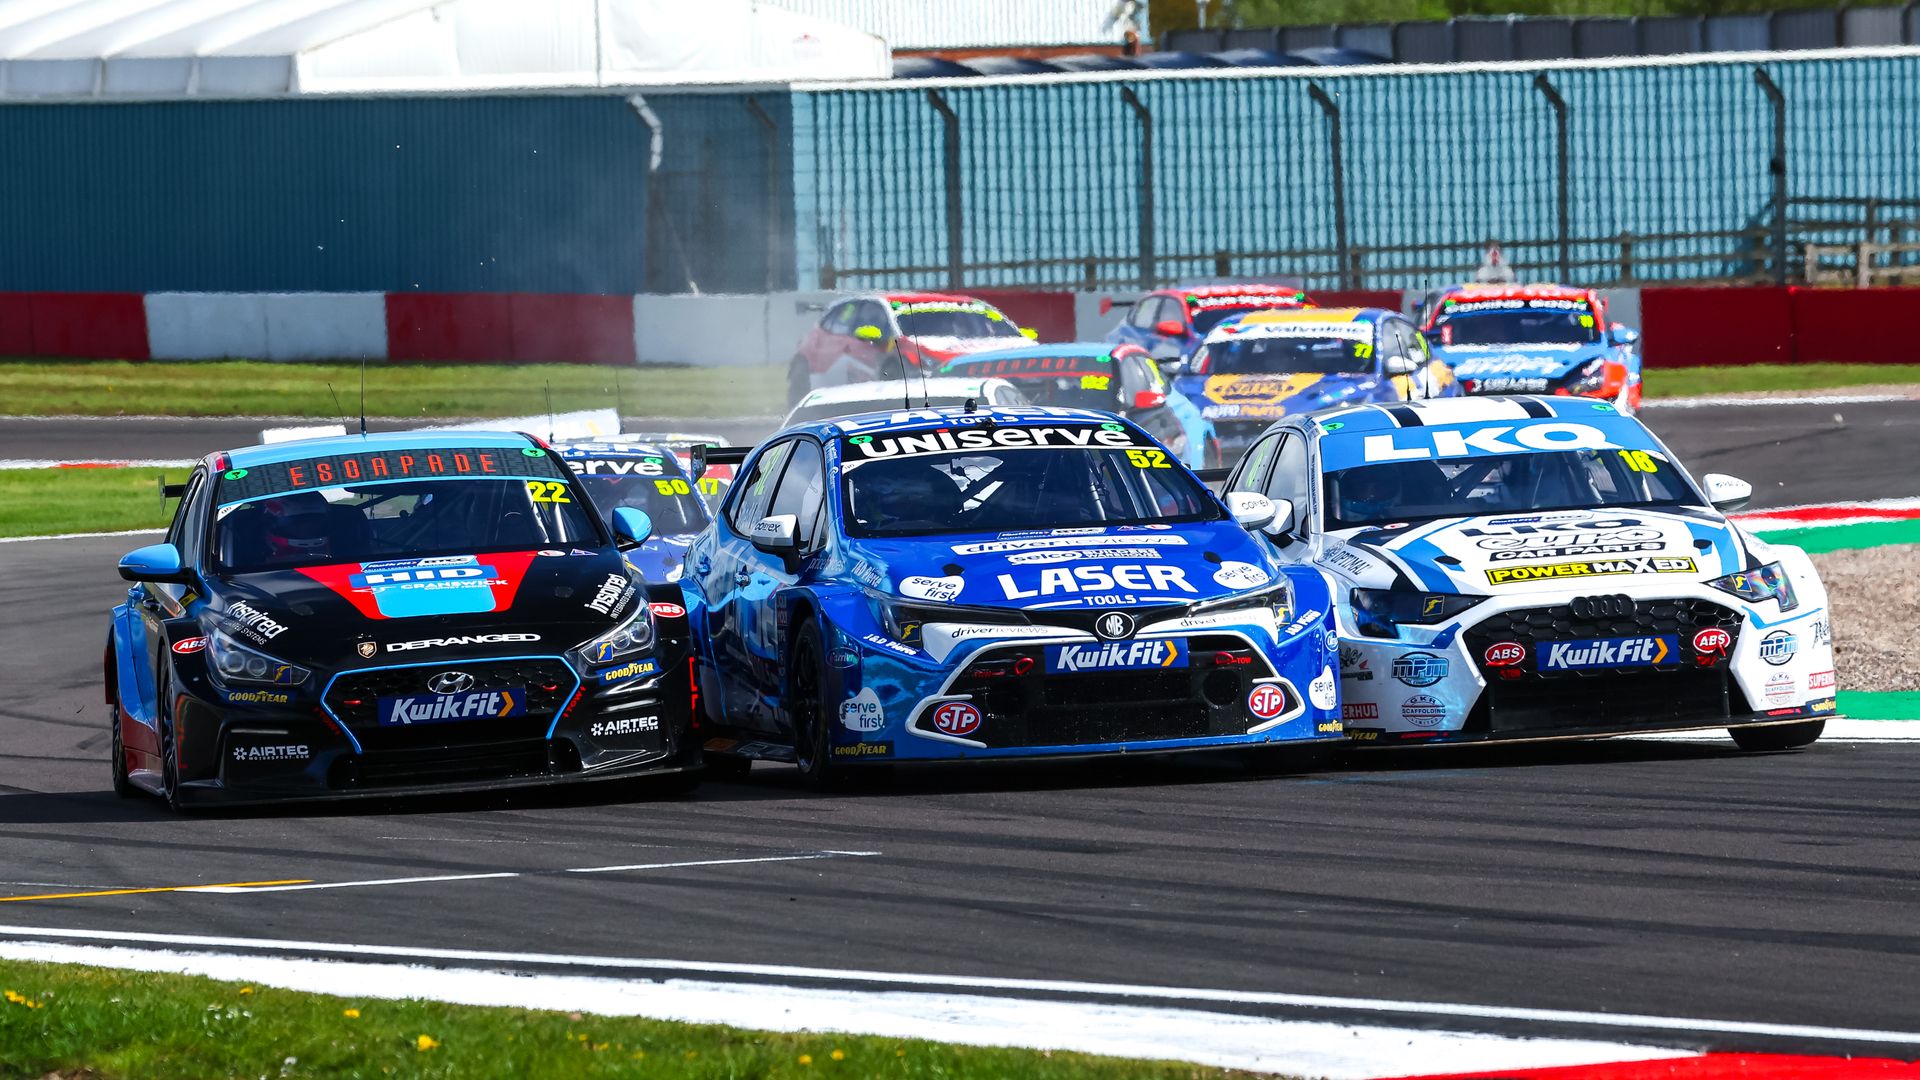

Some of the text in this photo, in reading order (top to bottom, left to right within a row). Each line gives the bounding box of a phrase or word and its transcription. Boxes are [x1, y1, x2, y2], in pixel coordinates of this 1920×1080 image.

[1364, 423, 1624, 463] LKQ
[566, 460, 664, 476] erve
[1125, 450, 1172, 469] 52
[527, 481, 571, 504] 22
[654, 478, 691, 496] 50
[699, 477, 719, 496] 17
[1461, 519, 1651, 537] LKQ
[1496, 542, 1661, 560] CAR PARTS
[365, 568, 484, 584] HID
[1219, 564, 1253, 581] serve
[1493, 562, 1592, 582] POWER
[912, 577, 957, 590] serve
[997, 565, 1199, 601] LASER
[584, 573, 628, 615] inspired
[1084, 594, 1137, 606] TOOLS
[653, 605, 681, 614] ABS
[226, 600, 289, 640] inspired
[178, 637, 208, 651] ABS
[241, 627, 268, 646] SYSTEMS
[386, 633, 542, 653] DERANGED
[863, 634, 917, 656] J&D Pierce
[1700, 634, 1726, 647] ABS
[1491, 647, 1520, 660] ABS
[605, 661, 654, 681] GOODYEAR
[228, 690, 288, 703] GOODYEAR
[1253, 689, 1281, 714] STP
[844, 702, 877, 713] serve
[1343, 704, 1378, 718] ERHUB
[604, 716, 659, 732] AIRTEC
[939, 706, 976, 731] STP
[249, 745, 309, 757] AIRTEC
[835, 742, 887, 757] GOODYEAR
